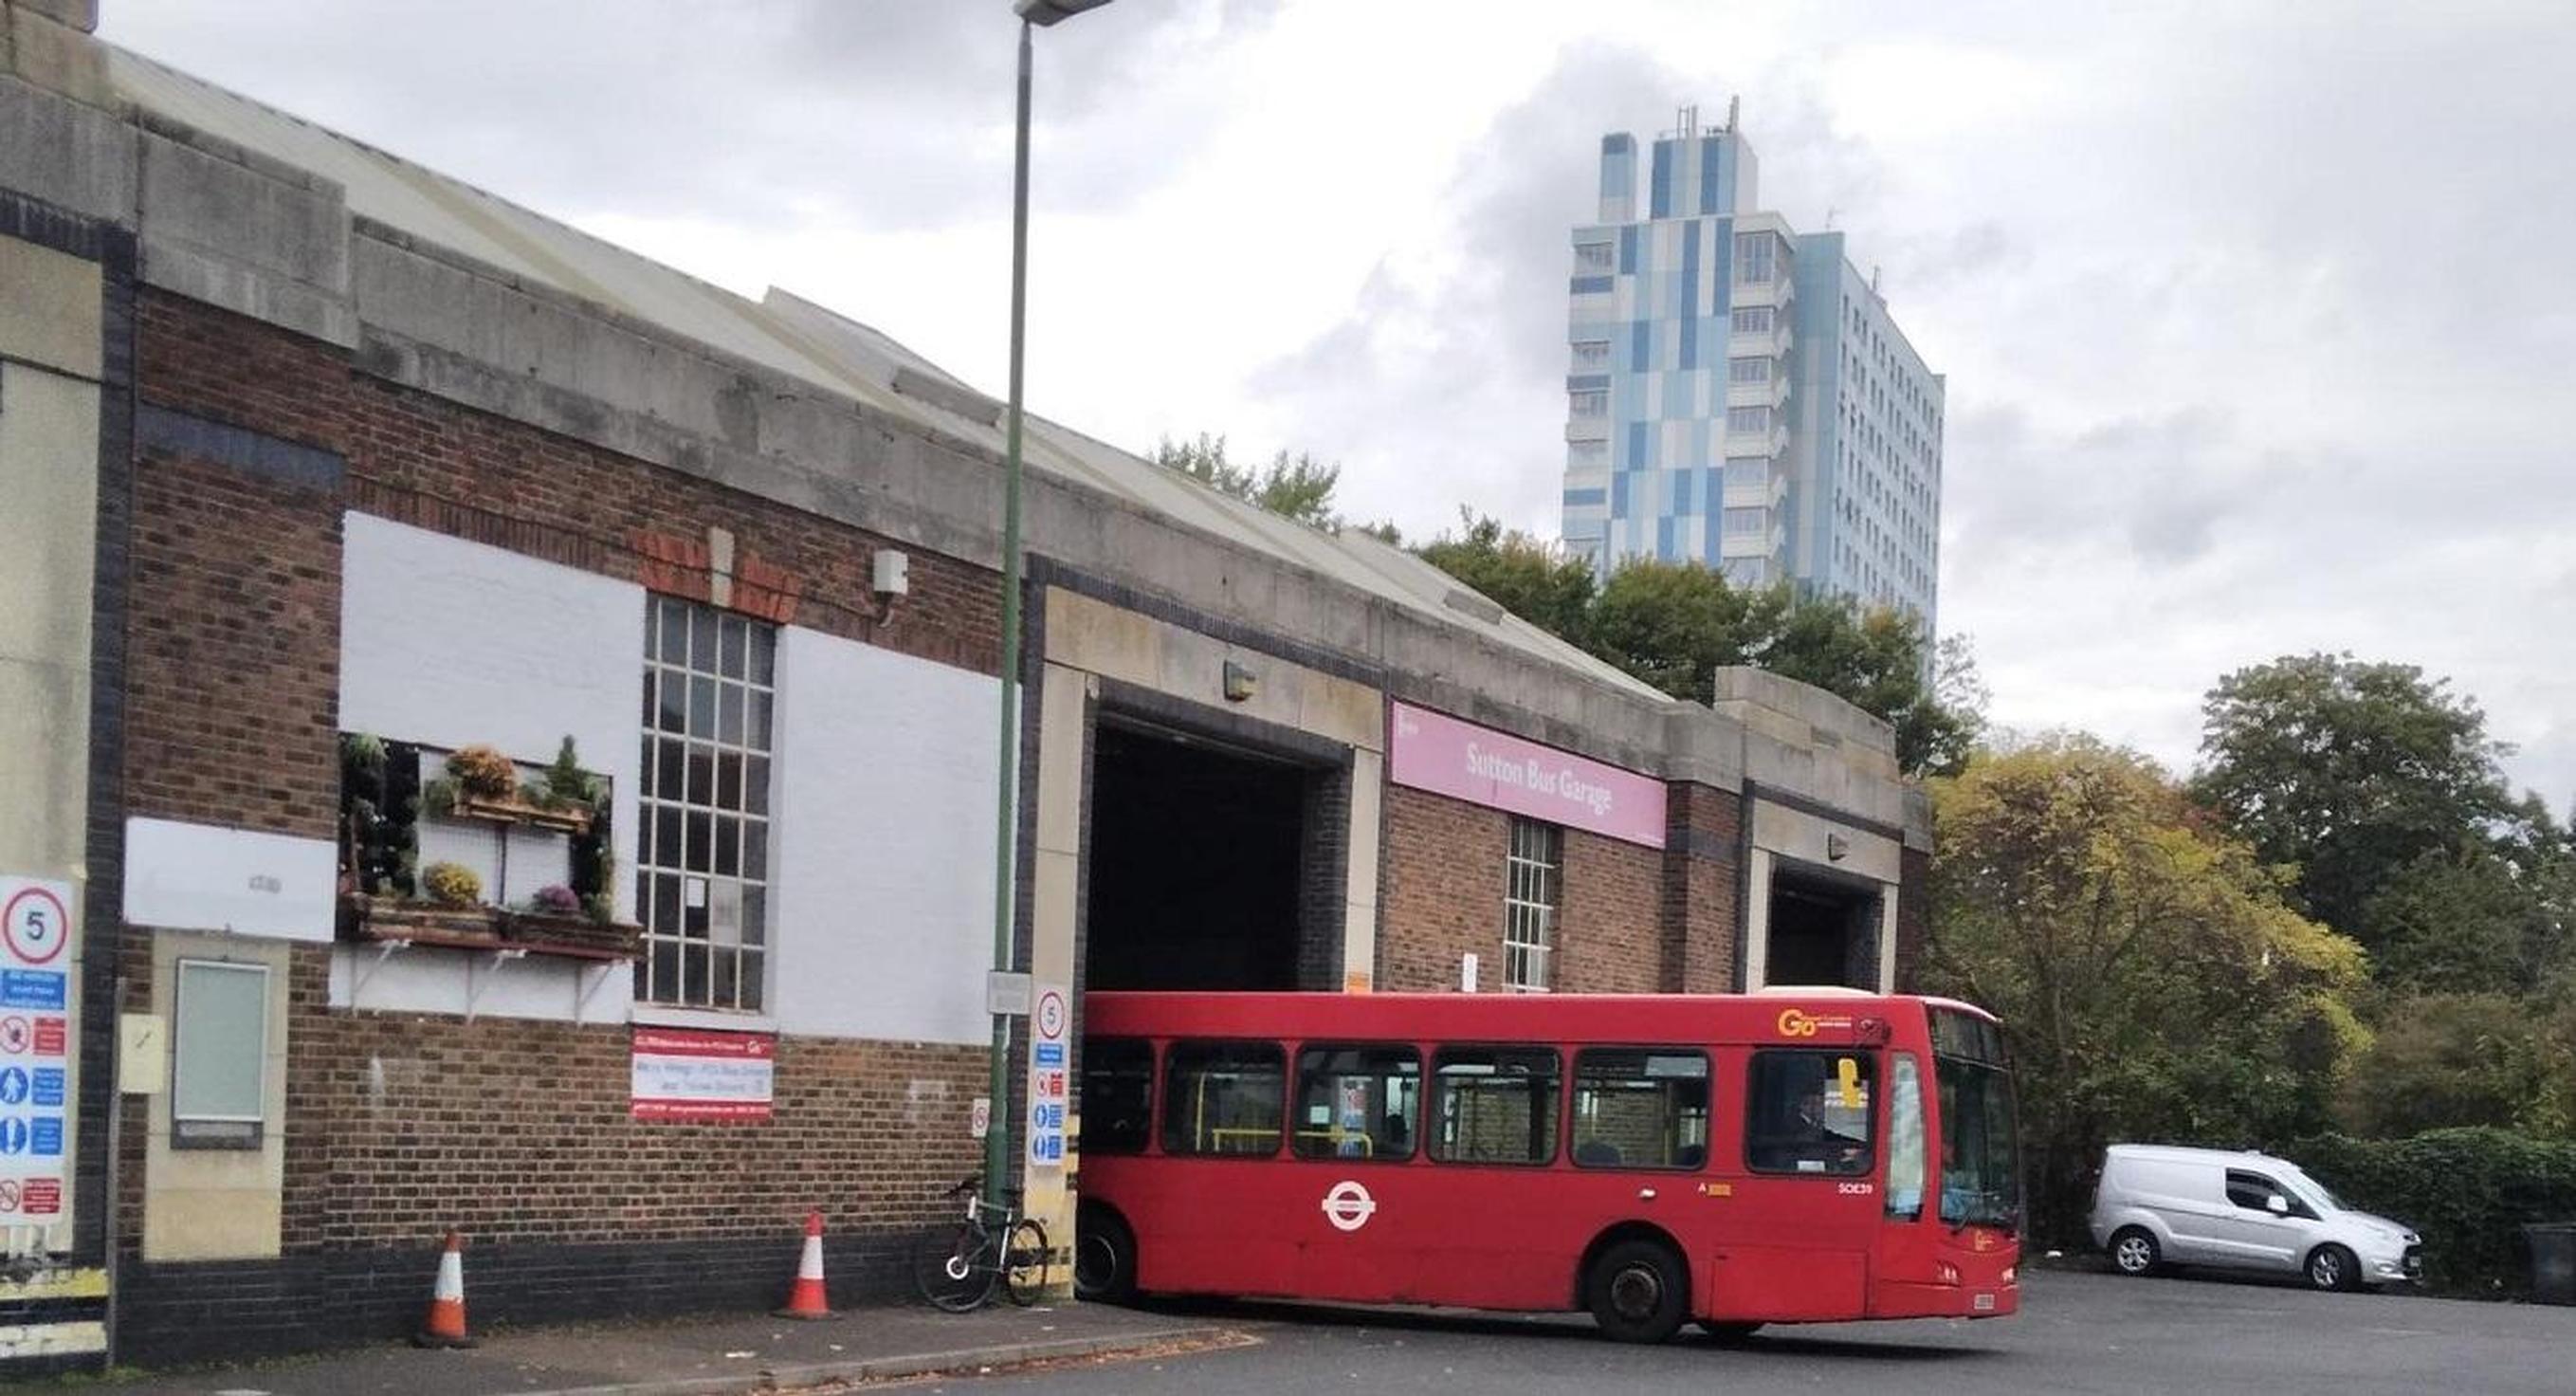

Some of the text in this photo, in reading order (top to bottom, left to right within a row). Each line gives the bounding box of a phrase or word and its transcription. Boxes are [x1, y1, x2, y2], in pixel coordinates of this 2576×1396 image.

[1467, 742, 1612, 817] Sutton Bus Garage
[27, 910, 46, 941] 5
[1778, 1009, 1816, 1037] Go
